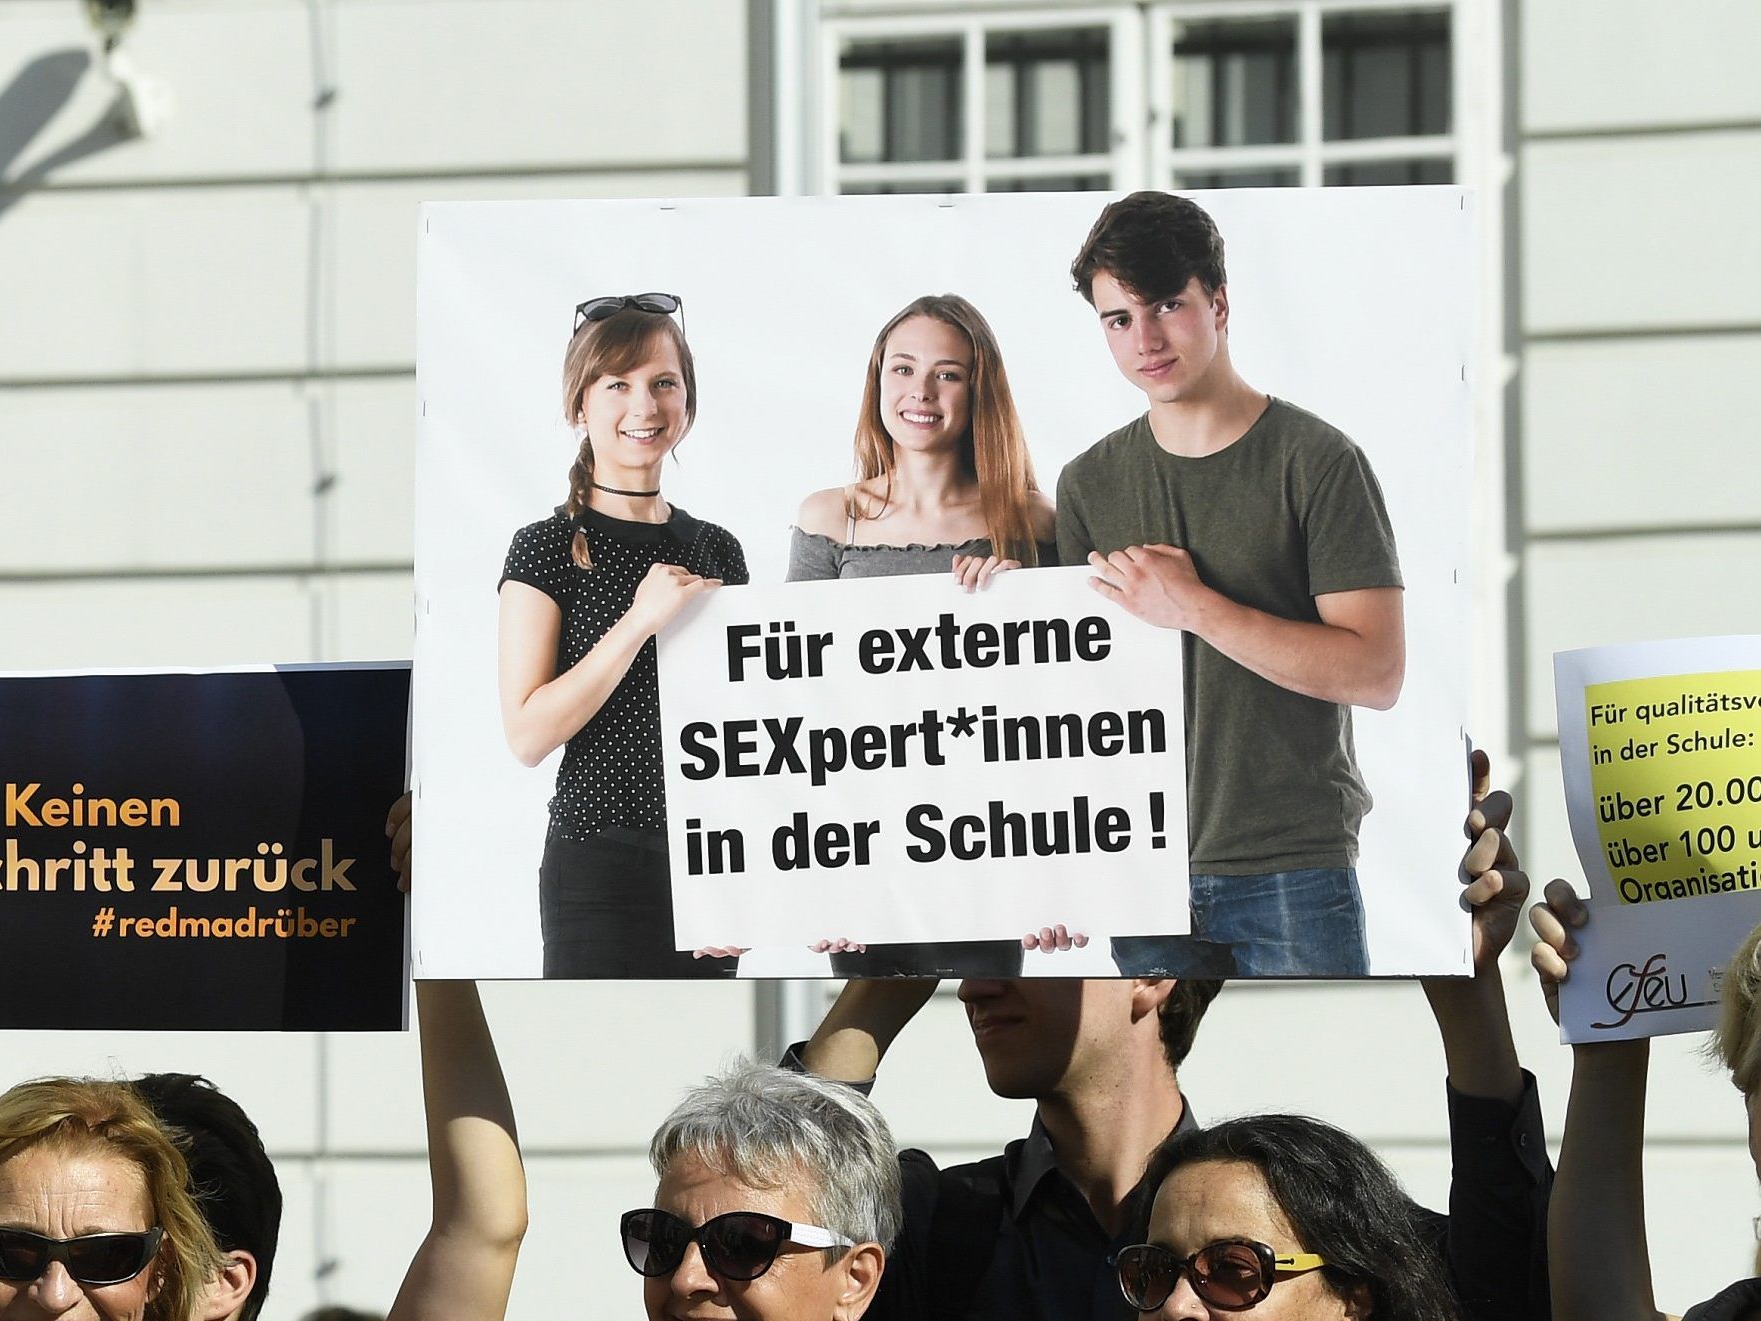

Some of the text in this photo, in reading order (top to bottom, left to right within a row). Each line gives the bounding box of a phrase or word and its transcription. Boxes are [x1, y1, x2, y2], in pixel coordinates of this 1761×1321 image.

[726, 613, 1111, 682] Für externe
[1591, 692, 1761, 727] Für qualitätsv
[1593, 727, 1754, 766] in der Schule:
[5, 783, 180, 827] Keinen
[1599, 790, 1665, 823] über
[686, 818, 745, 875] in
[771, 812, 880, 871] der
[905, 796, 1131, 862] Schule
[1607, 839, 1669, 868] über
[1679, 825, 1736, 858] 100
[151, 838, 357, 893] zurück
[1620, 861, 1761, 904] Organisati
[92, 907, 357, 939] #redmadrüber
